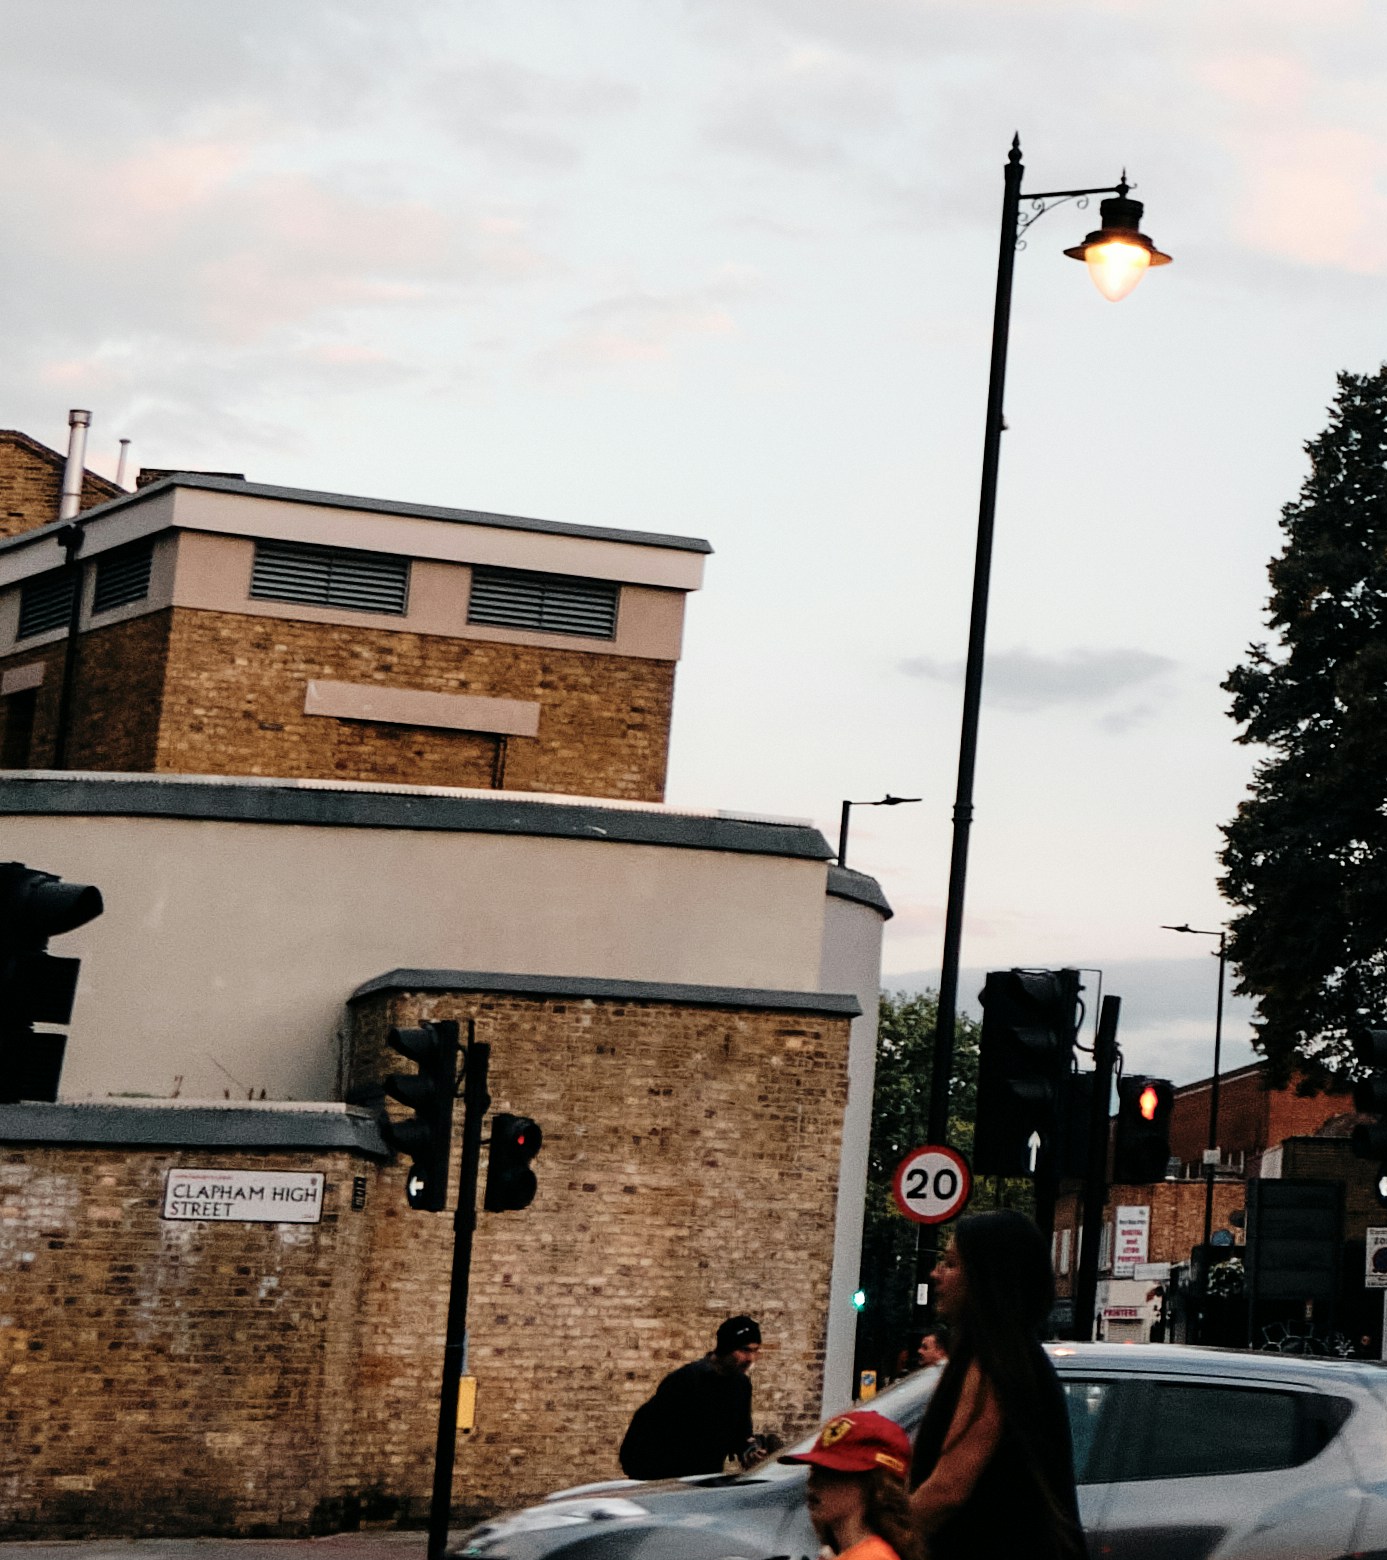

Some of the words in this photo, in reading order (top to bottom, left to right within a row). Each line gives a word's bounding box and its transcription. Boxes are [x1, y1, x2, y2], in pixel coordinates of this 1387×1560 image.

[172, 1183, 264, 1201] CLAPHAM
[272, 1186, 317, 1202] HIGH
[906, 1168, 957, 1200] 20
[170, 1200, 234, 1217] STREET
[1103, 1308, 1138, 1317] PRINTERS
